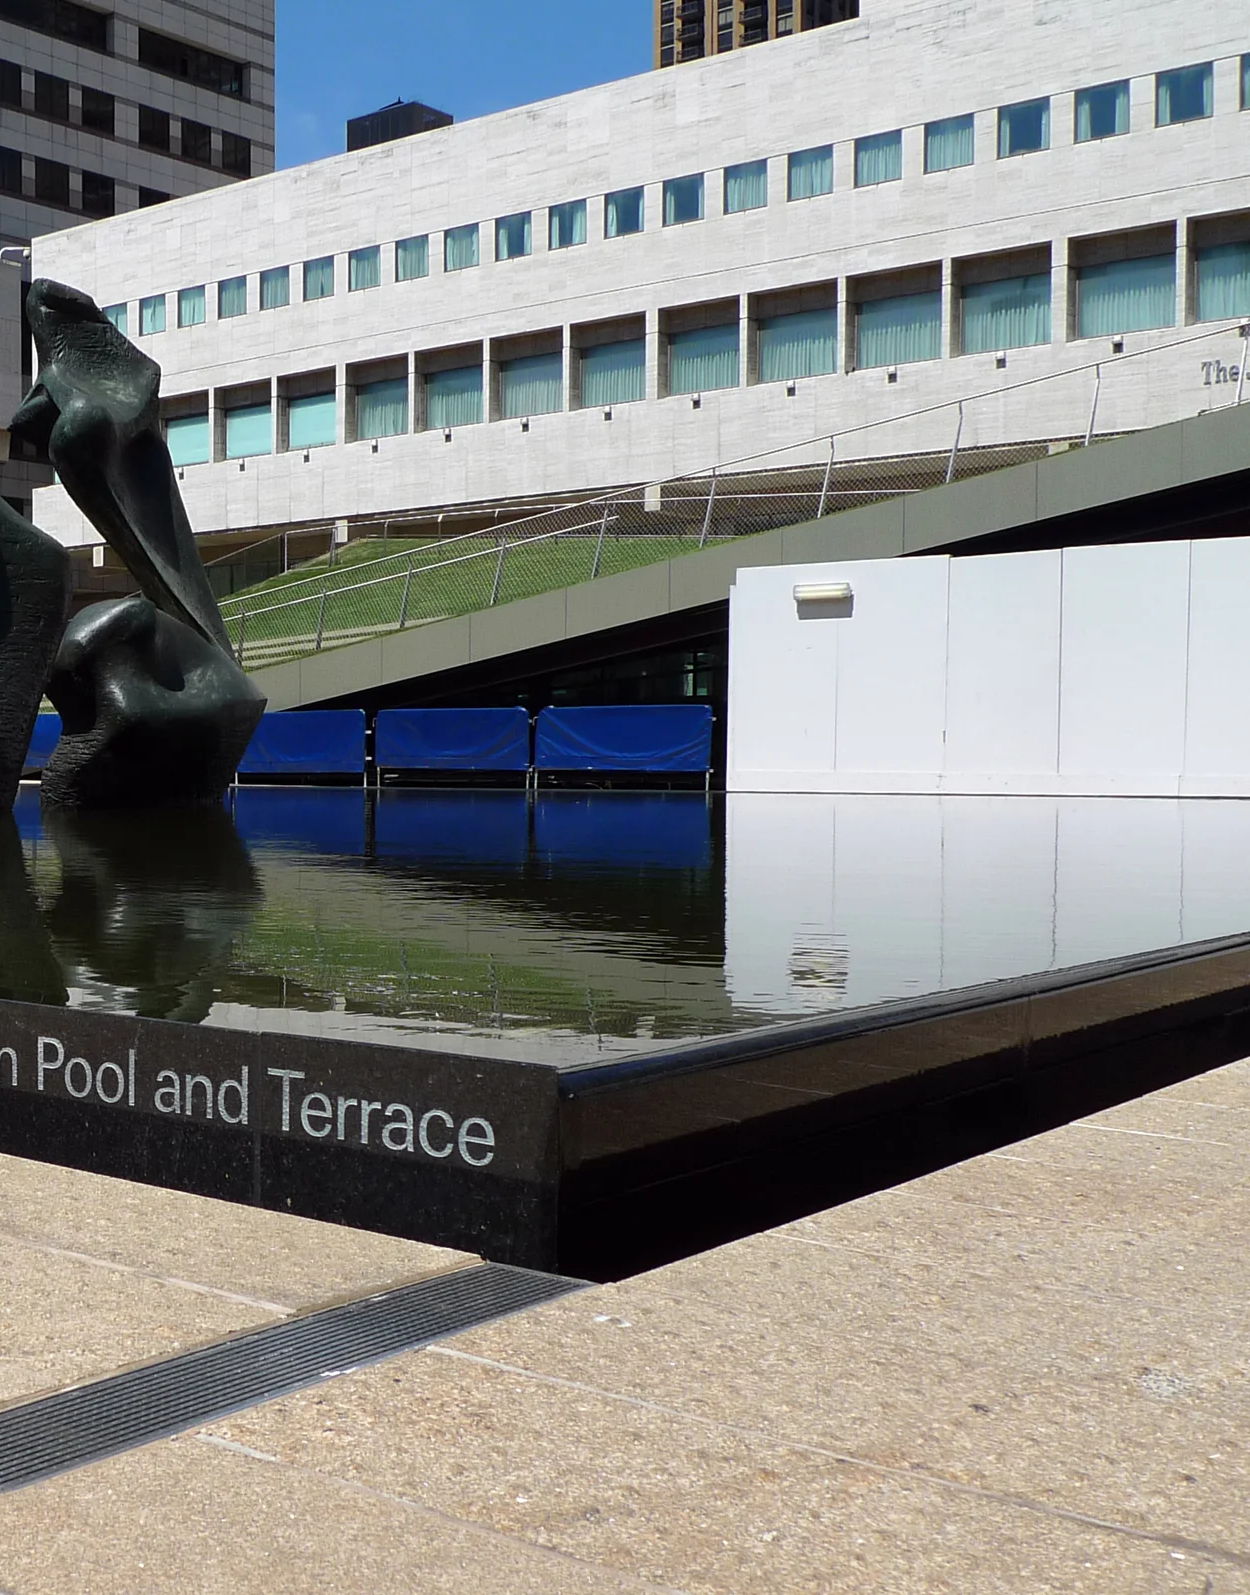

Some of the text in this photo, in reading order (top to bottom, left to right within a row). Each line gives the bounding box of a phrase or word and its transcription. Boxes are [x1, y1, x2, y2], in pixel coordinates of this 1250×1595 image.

[1201, 359, 1240, 386] The
[37, 1035, 137, 1107] Pool
[154, 1065, 249, 1126] and
[267, 1067, 496, 1167] Terrace
